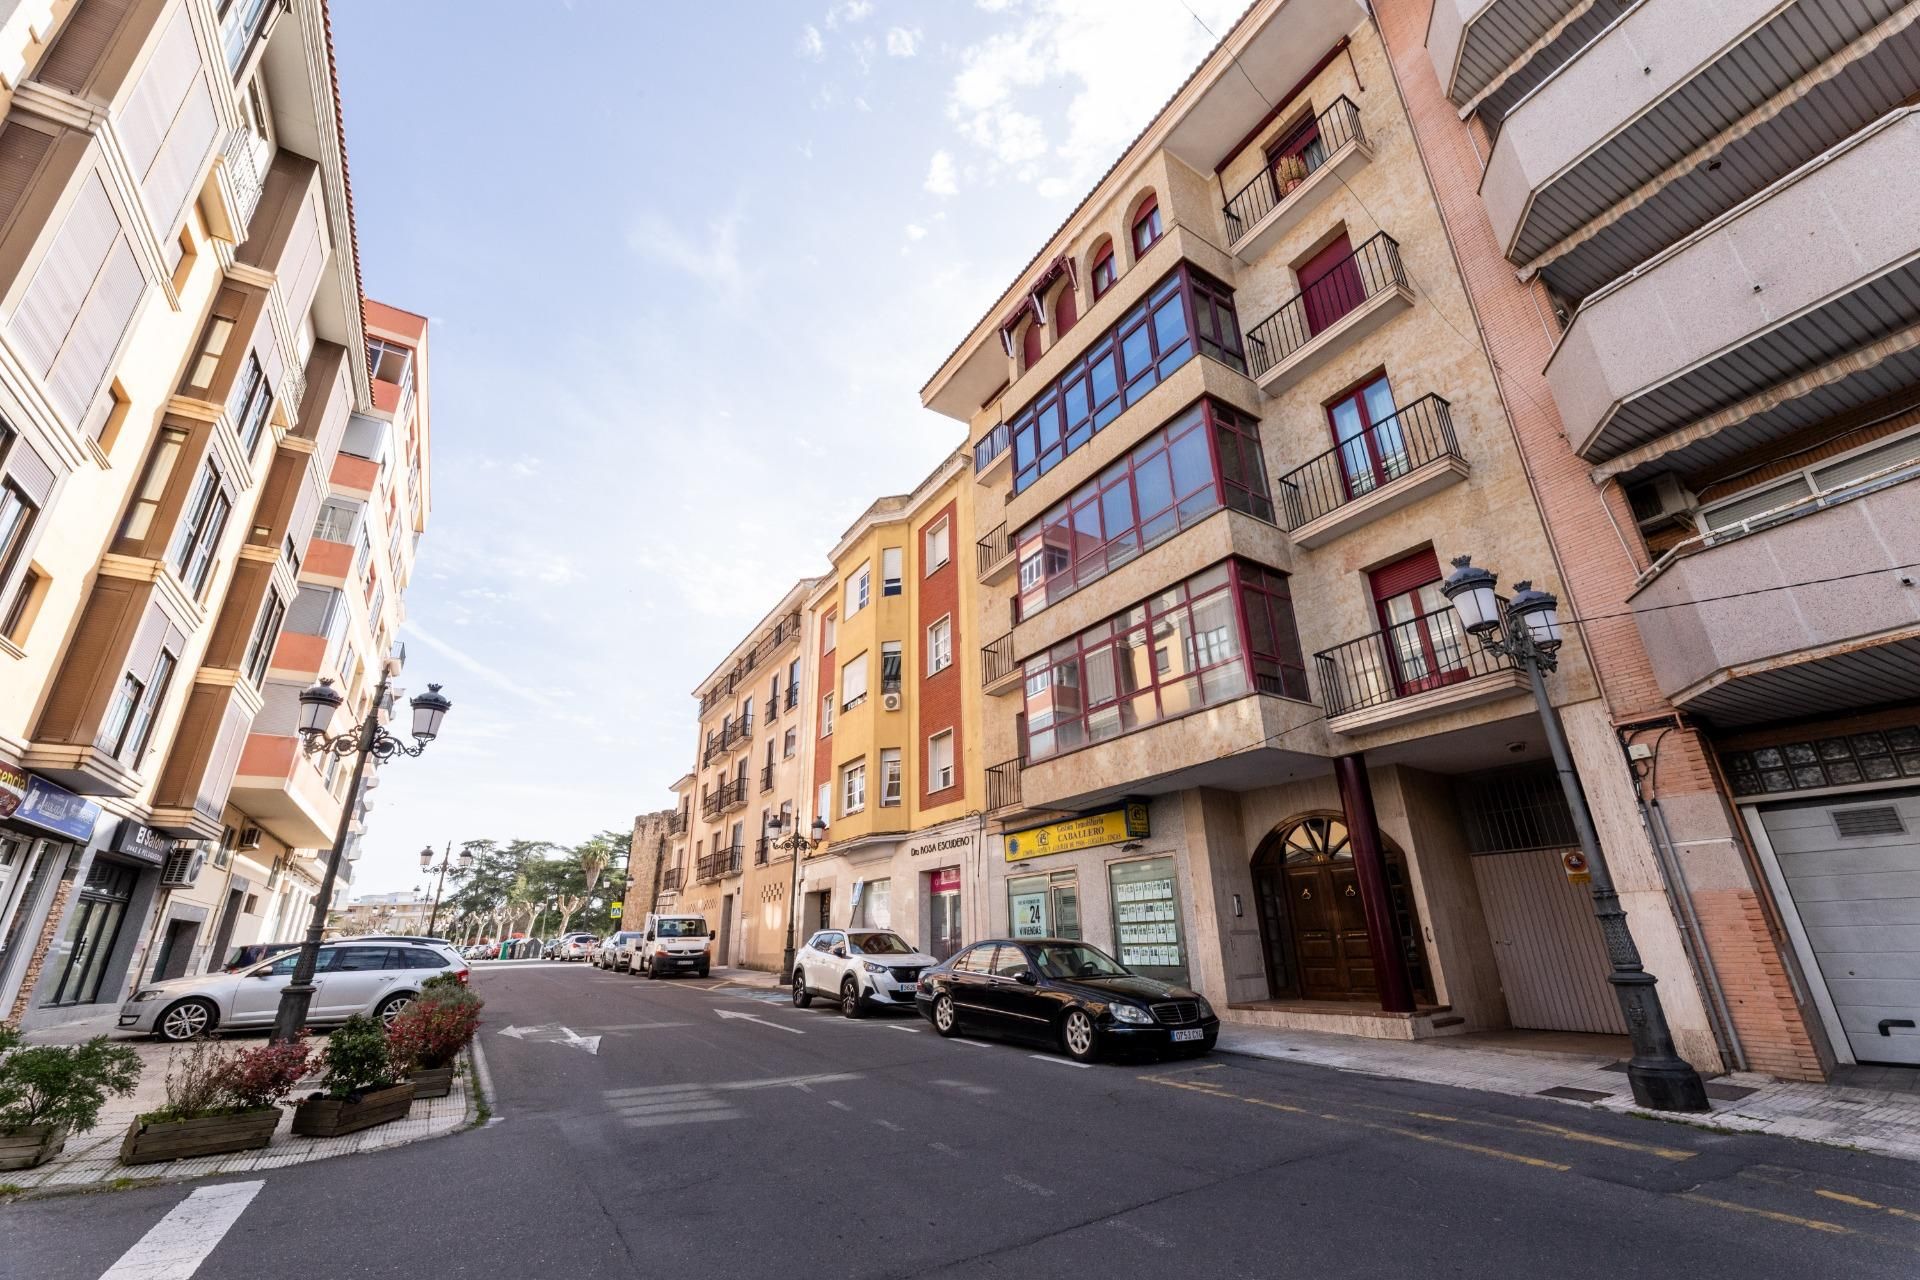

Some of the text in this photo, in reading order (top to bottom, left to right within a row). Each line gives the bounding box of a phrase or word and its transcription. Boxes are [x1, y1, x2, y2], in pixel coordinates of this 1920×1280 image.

[0, 768, 26, 791] encia
[136, 826, 147, 844] El
[1057, 827, 1104, 841] CABALLERO
[937, 836, 970, 852] ESCUDERO
[1029, 904, 1041, 923] 24
